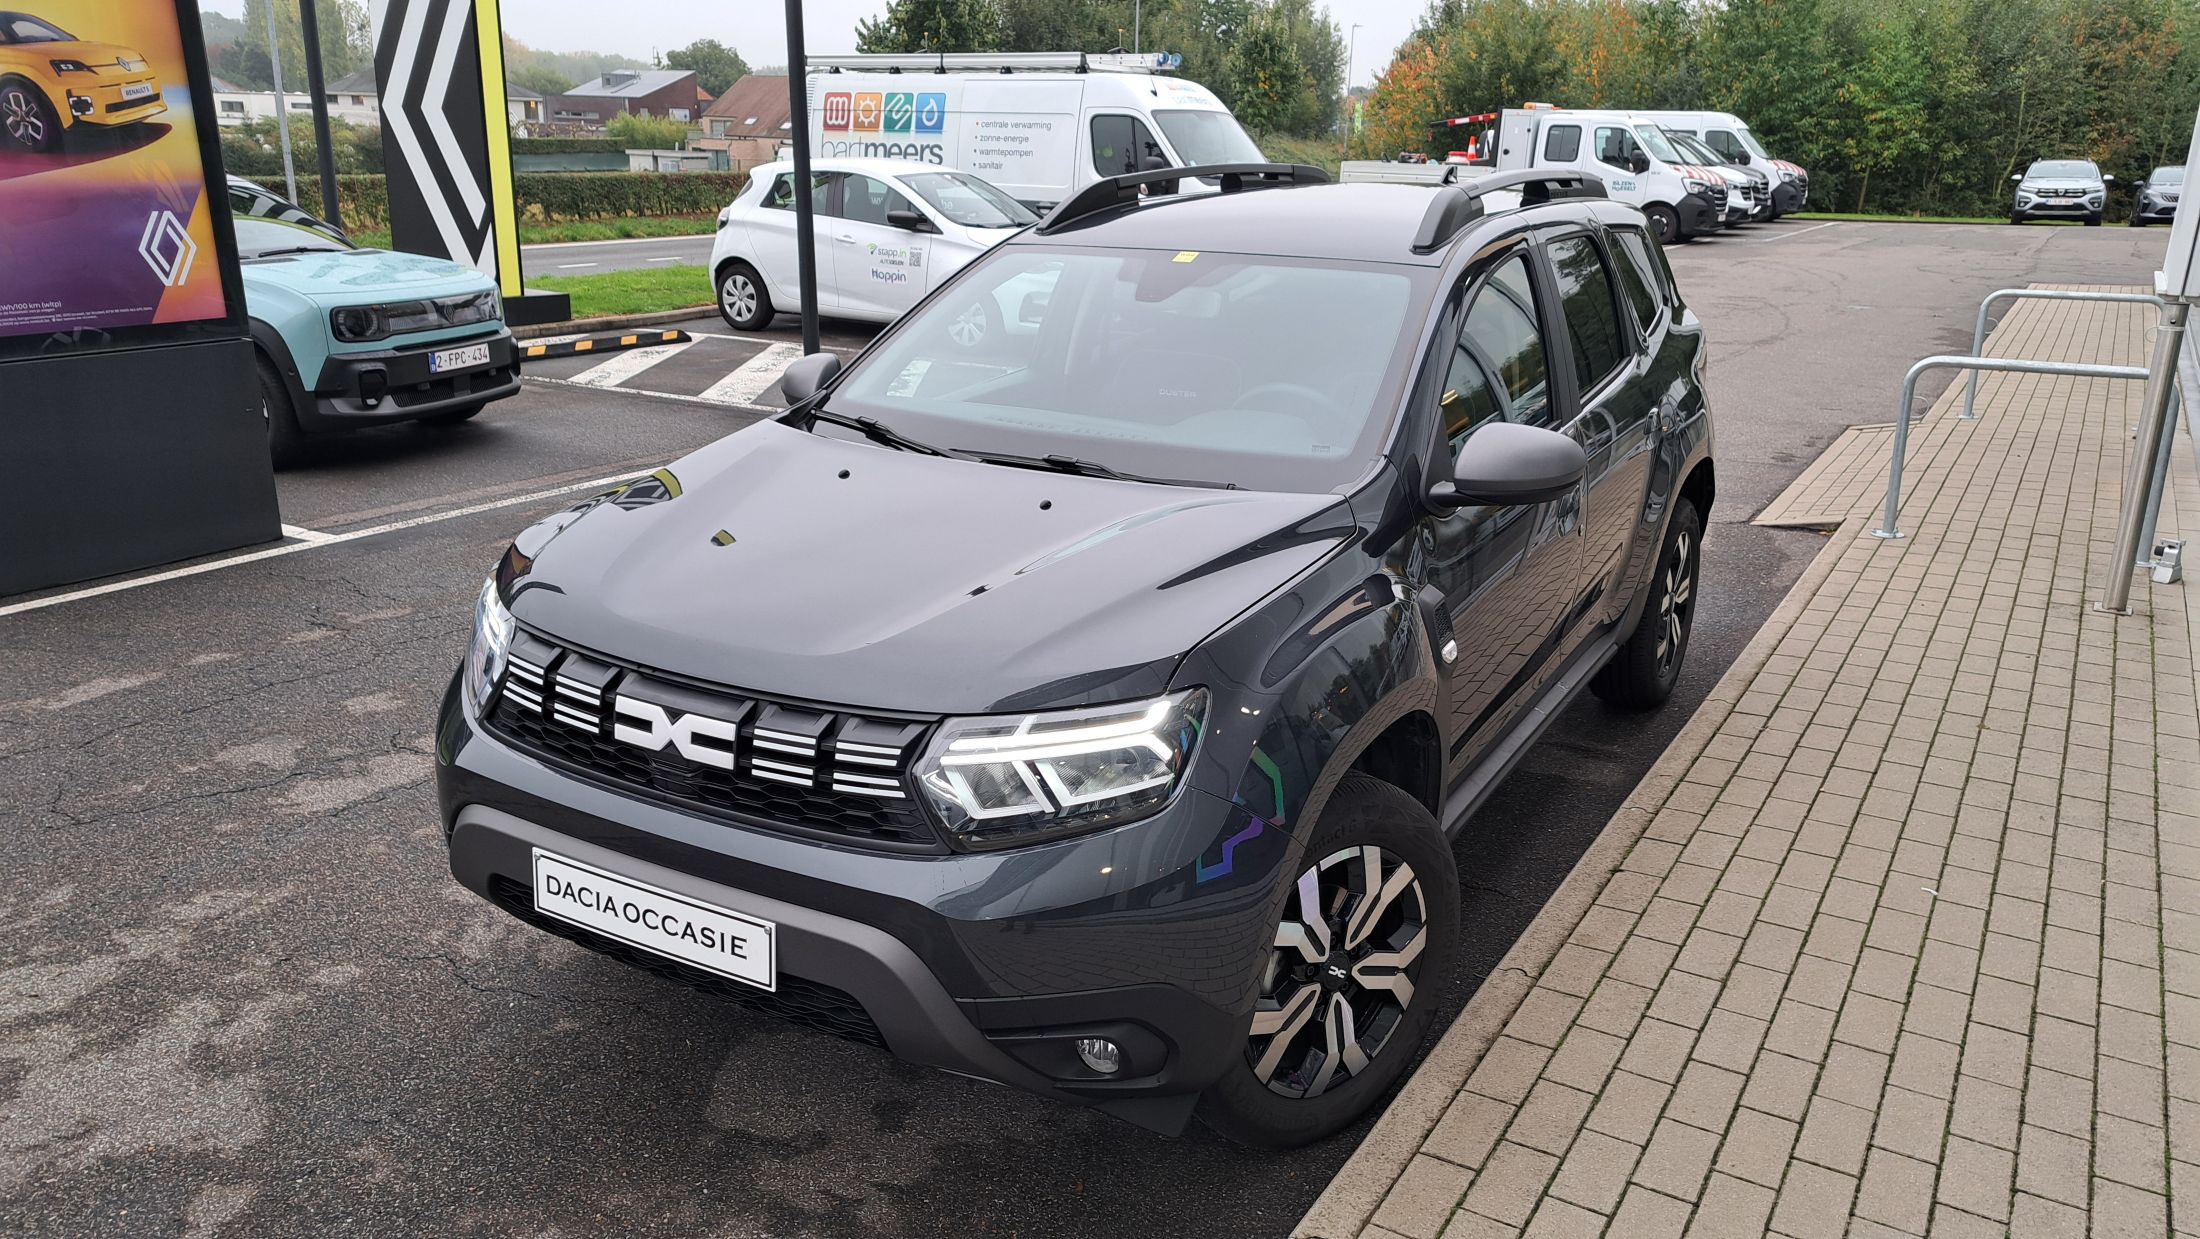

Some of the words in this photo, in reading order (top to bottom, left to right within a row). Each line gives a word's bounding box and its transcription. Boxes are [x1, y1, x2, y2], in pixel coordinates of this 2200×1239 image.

[980, 120, 1008, 129] centrale
[1011, 120, 1052, 132] verwarming
[979, 134, 1030, 145] zonne-energie
[979, 148, 1034, 160] warmtepompen
[978, 160, 1004, 170] sanitair
[877, 247, 907, 259] stapp.in
[871, 267, 907, 283] Hoppin
[545, 873, 620, 919] DACIA
[622, 902, 749, 961] OCCASIE
